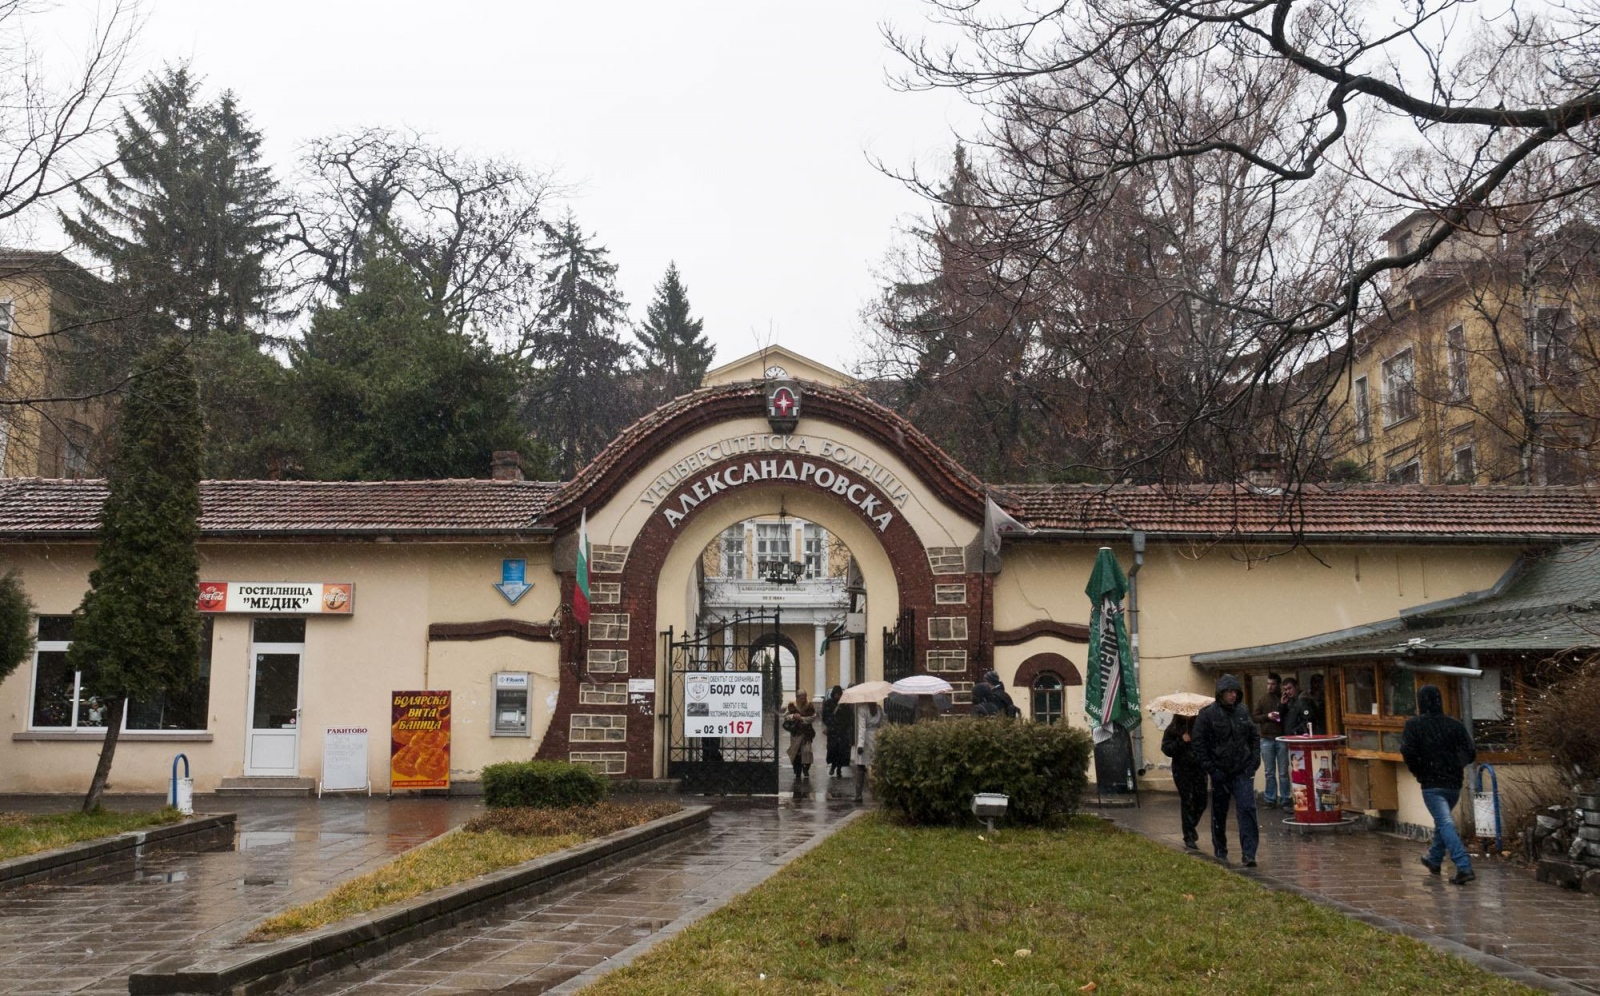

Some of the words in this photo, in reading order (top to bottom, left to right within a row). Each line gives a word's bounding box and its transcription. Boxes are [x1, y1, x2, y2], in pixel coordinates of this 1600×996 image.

[819, 440, 909, 509] БОЛНИЦА
[663, 459, 893, 532] АЛЕКСАНДРОВСКА
[239, 586, 313, 597] ГОСТИЛНИЦА
[710, 684, 736, 696] БОДУ
[740, 684, 760, 696] СОД
[393, 695, 448, 708] БОЛЯРСКА
[407, 708, 437, 717] ВИТА
[398, 720, 442, 732] БАНИЦА
[703, 724, 714, 734] 02
